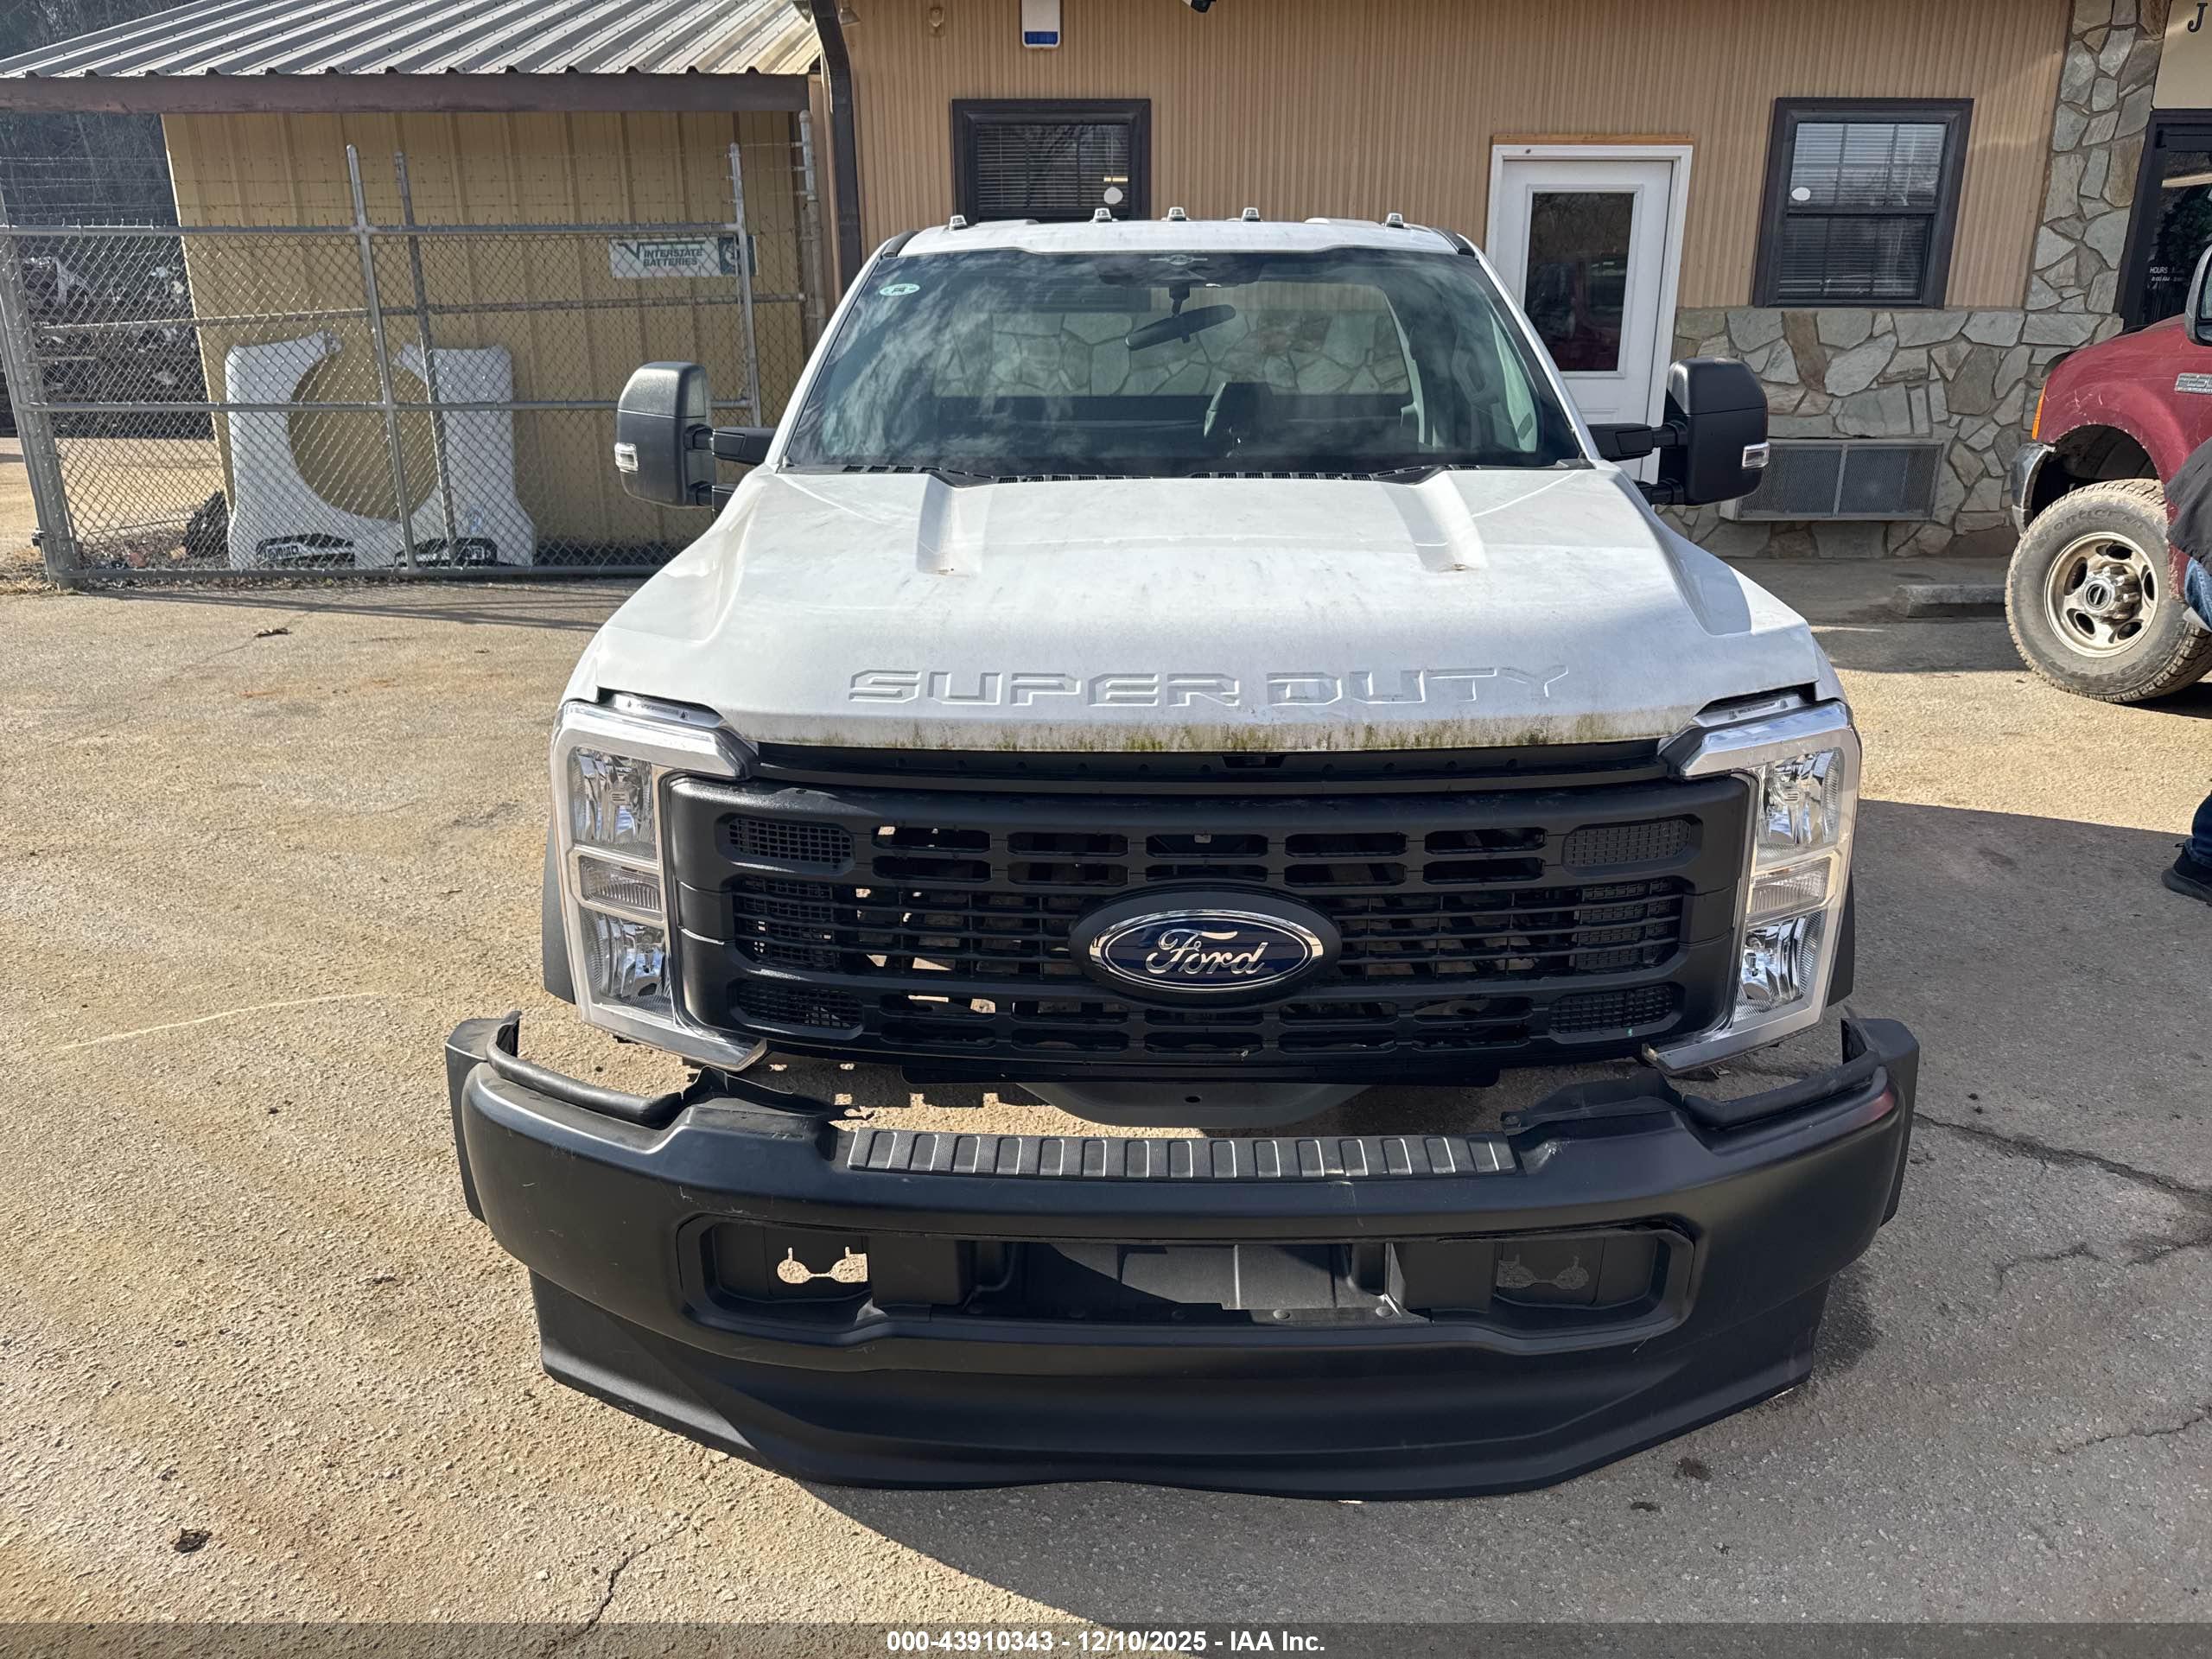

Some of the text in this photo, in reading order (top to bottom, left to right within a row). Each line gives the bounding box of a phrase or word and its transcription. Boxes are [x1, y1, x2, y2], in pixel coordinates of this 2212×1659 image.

[2187, 3, 2209, 33] J
[643, 257, 698, 266] BATTERIES
[644, 249, 703, 257] INTERSTATE
[849, 664, 1569, 707] SUPER DUTY
[1145, 928, 1265, 975] Ford
